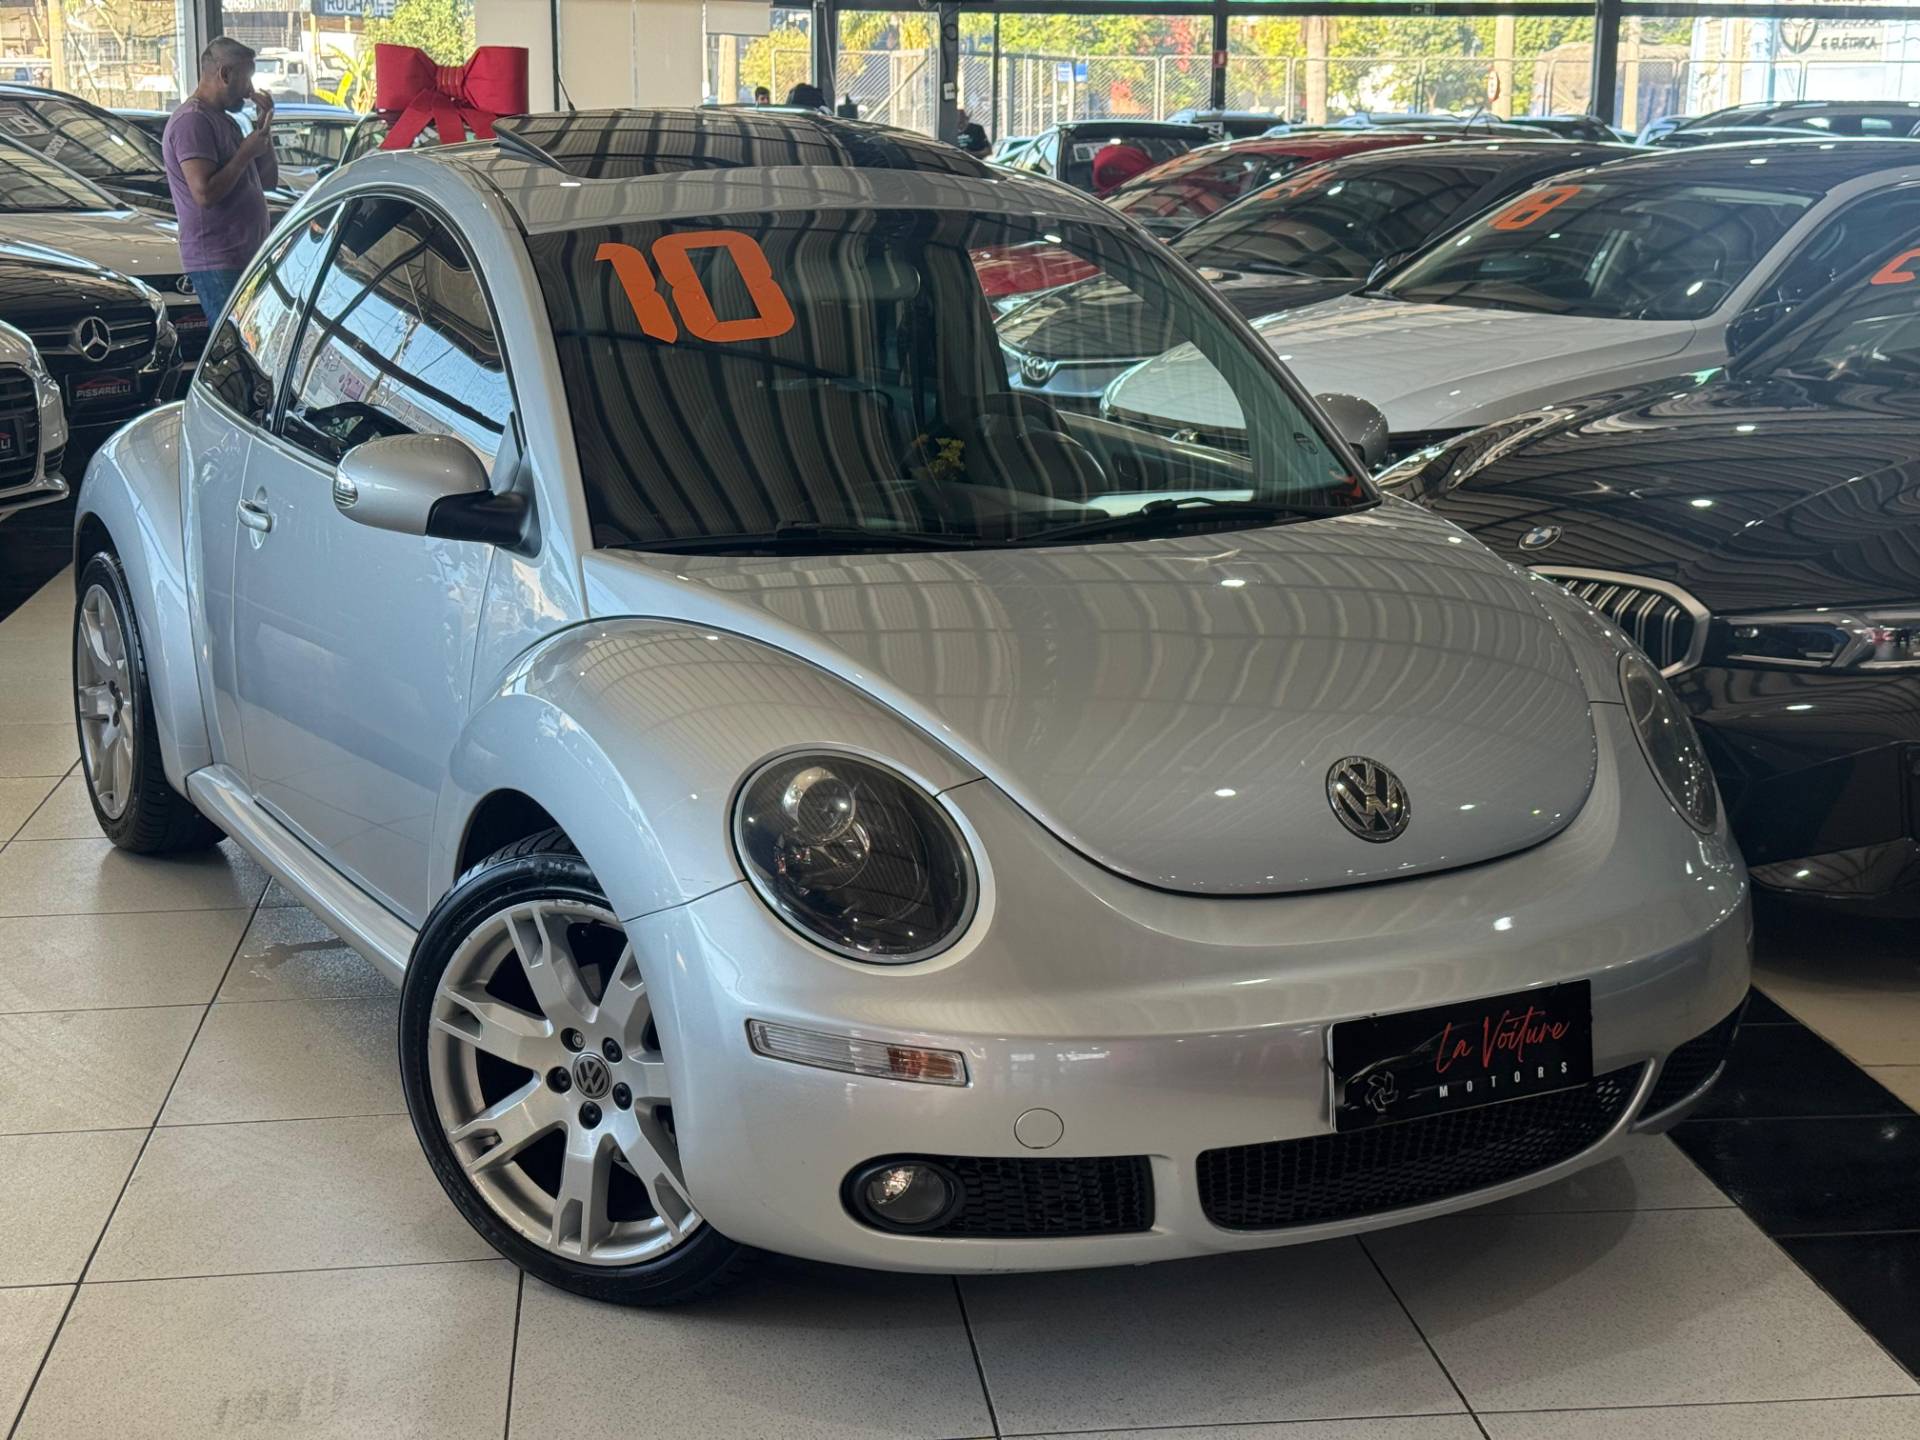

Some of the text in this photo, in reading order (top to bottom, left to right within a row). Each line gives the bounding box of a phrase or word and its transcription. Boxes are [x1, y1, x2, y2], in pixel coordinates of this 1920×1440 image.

[594, 230, 795, 344] 10
[76, 383, 131, 399] PISSARELLI
[1436, 1006, 1570, 1073] La Voiture
[1439, 1061, 1567, 1098] MOTORS
